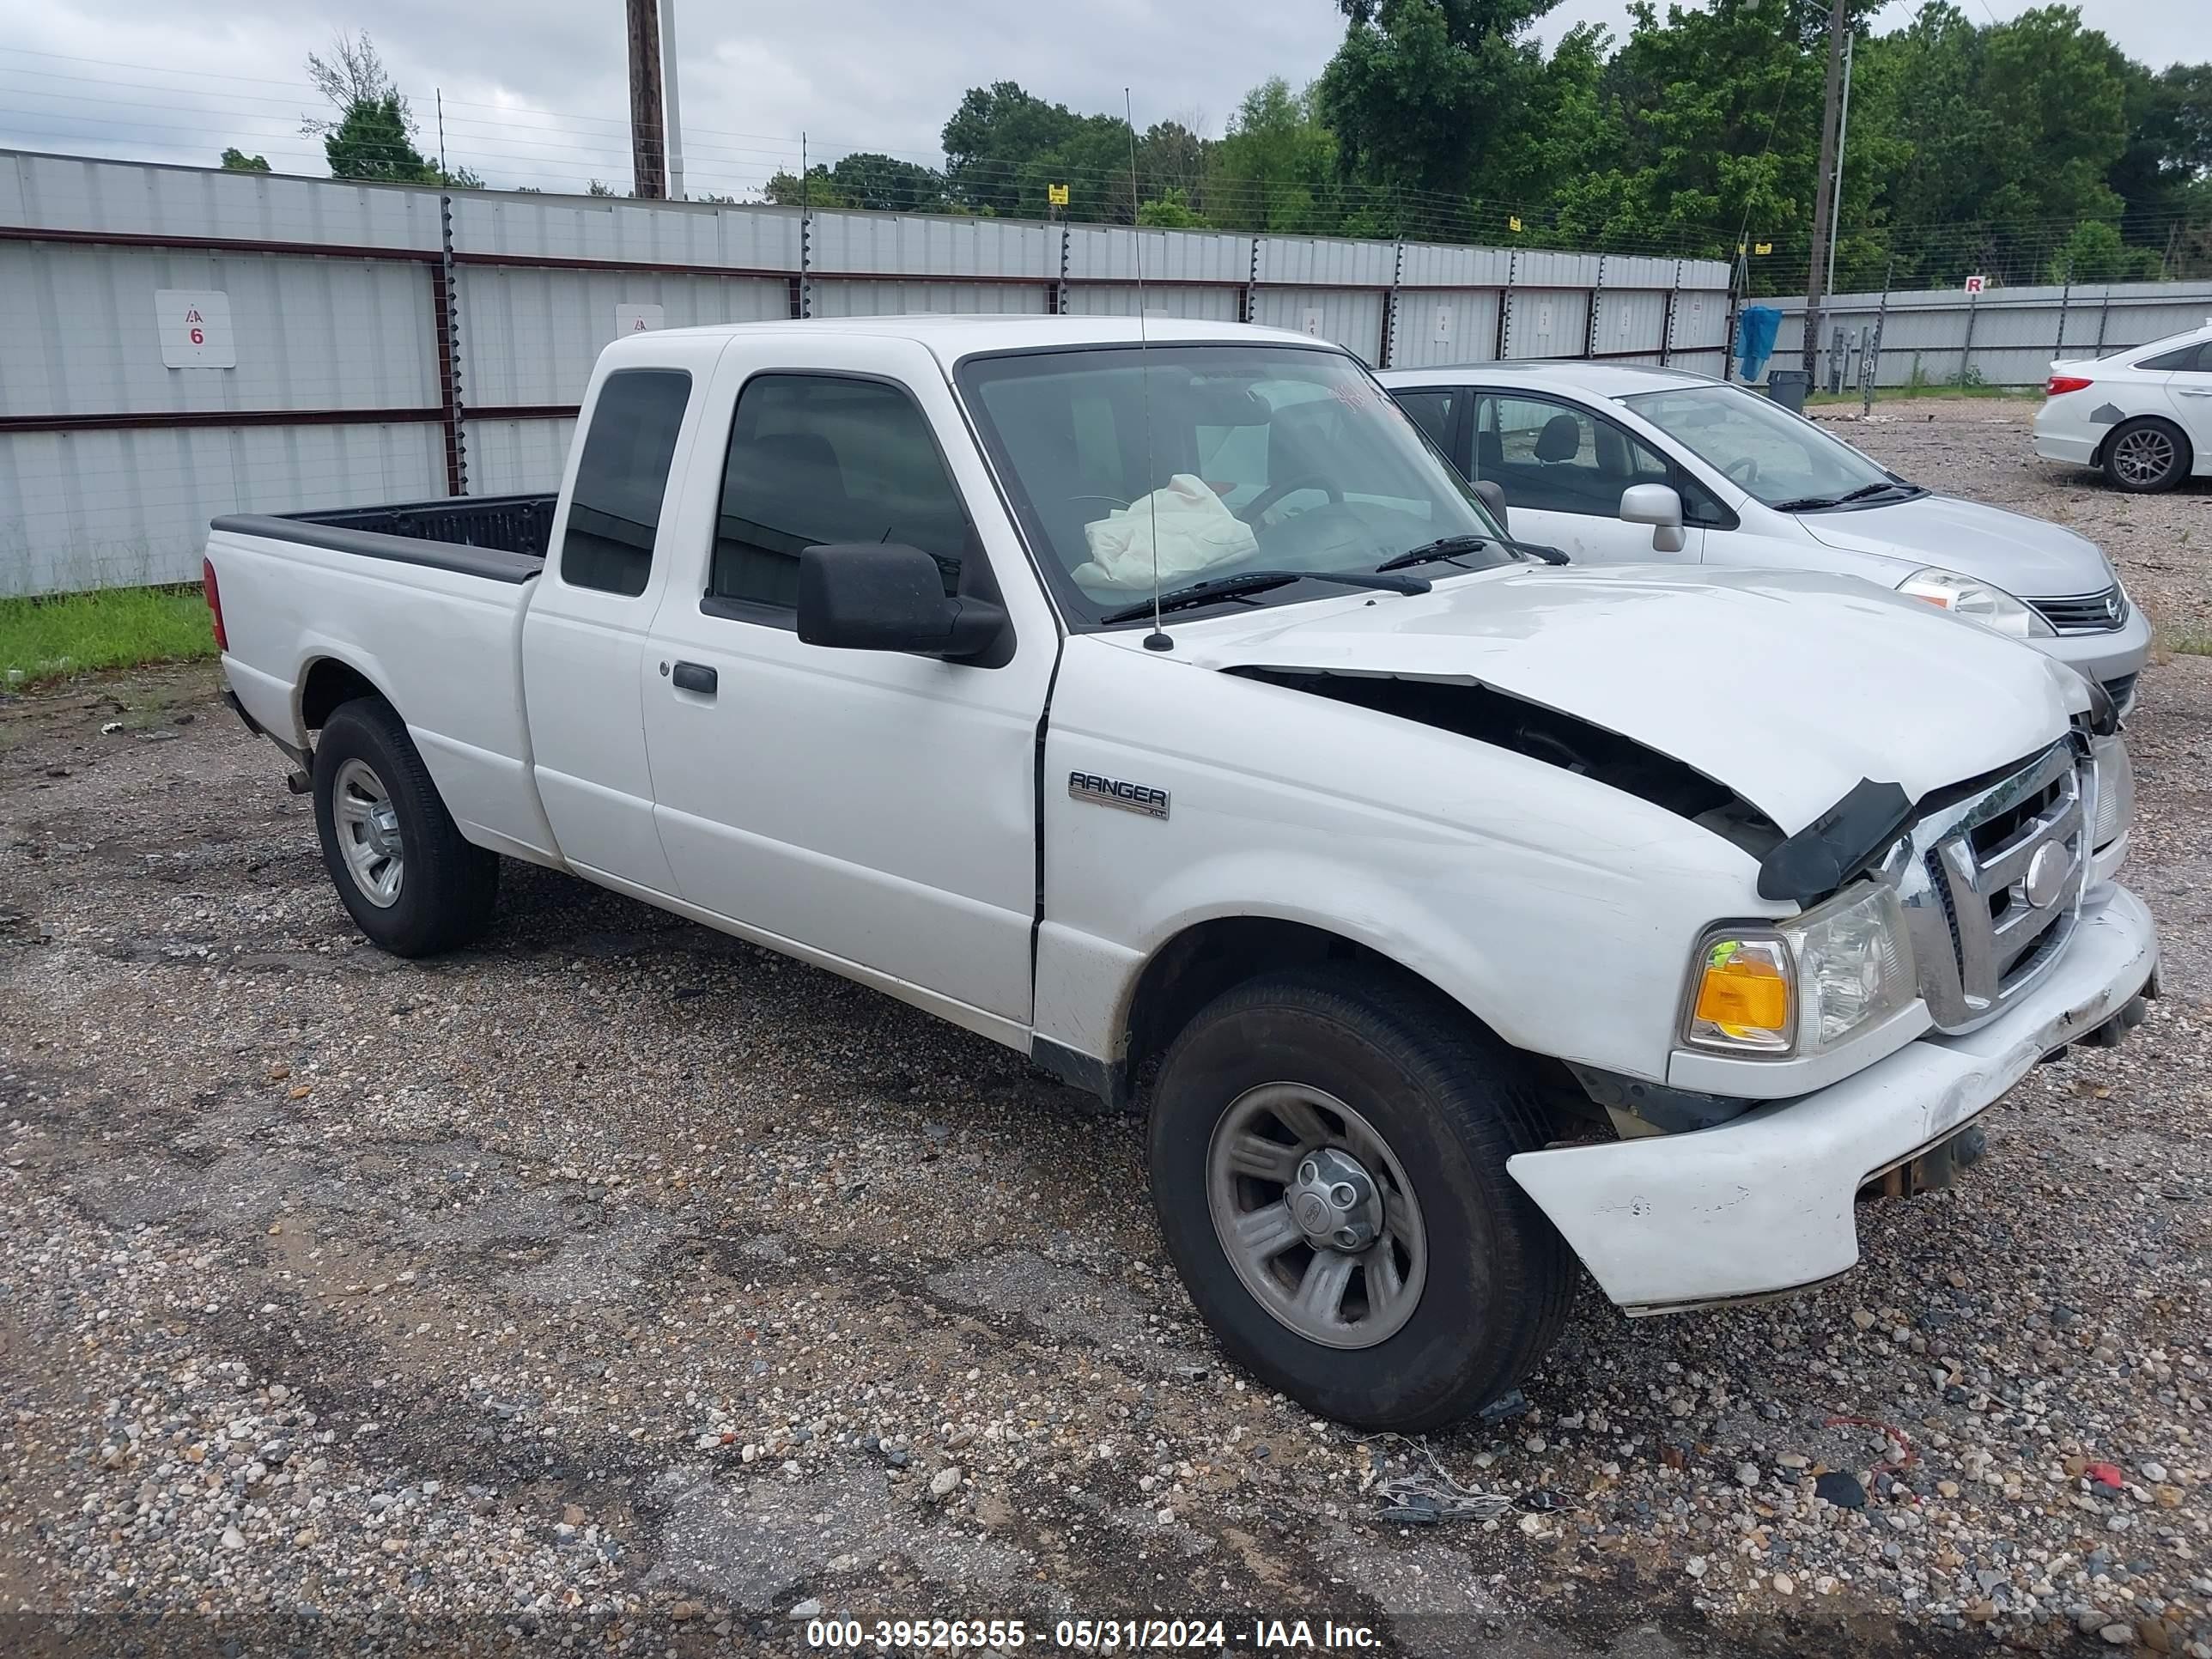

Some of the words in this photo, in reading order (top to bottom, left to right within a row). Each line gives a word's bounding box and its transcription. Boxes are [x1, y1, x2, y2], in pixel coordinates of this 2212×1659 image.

[1968, 279, 1981, 291] R
[191, 328, 204, 344] 6
[1070, 771, 1166, 807] RANGER
